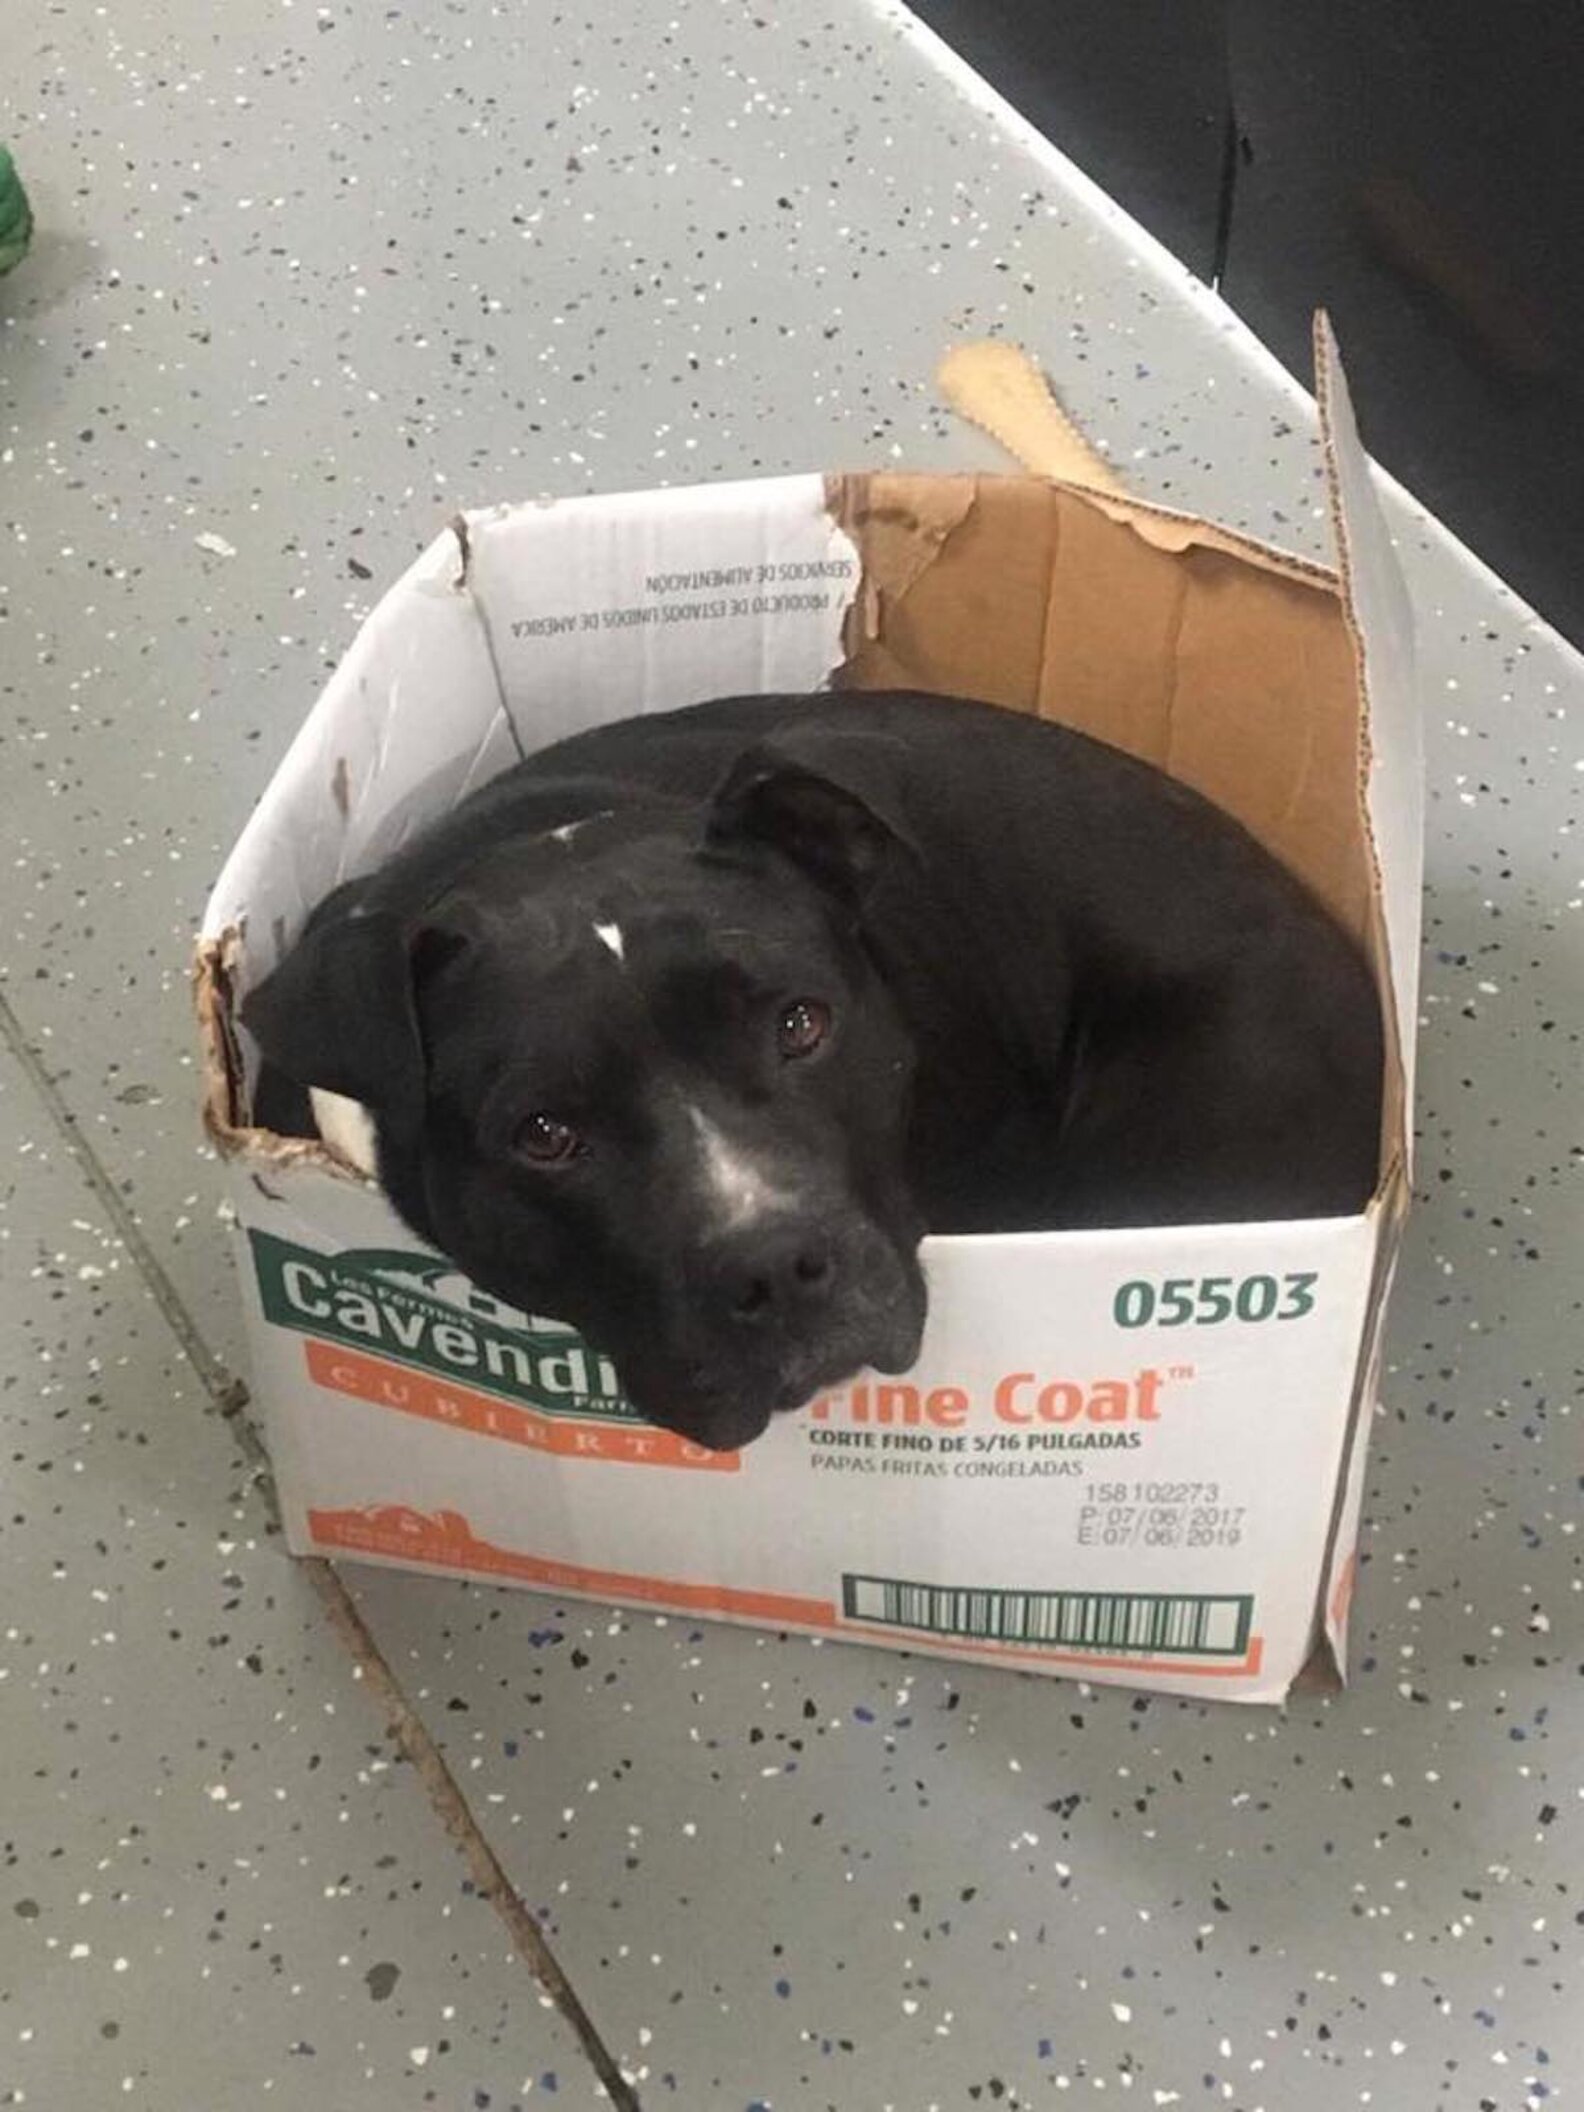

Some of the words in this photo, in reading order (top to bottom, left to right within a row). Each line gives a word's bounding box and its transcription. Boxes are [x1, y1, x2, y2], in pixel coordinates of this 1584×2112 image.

[646, 567, 753, 593] ALIMENTACIÓN
[756, 565, 776, 583] DE
[779, 560, 852, 581] SERVICIOS
[662, 601, 727, 622] ESTADOS
[730, 598, 749, 618] DE
[751, 594, 829, 615] PRODUCTO
[579, 612, 599, 630] DE
[603, 606, 659, 628] UNIDOS
[1113, 1272, 1319, 1329] 05503
[331, 1365, 714, 1461] CUBIERTO
[809, 1429, 876, 1448] CORTE
[882, 1433, 933, 1451] FINO
[940, 1436, 967, 1453] DE
[972, 1433, 1021, 1454] 5/16
[1027, 1431, 1142, 1450] PULGADAS
[811, 1454, 876, 1473] PAPAS
[882, 1459, 947, 1476] FRITAS
[954, 1459, 1084, 1478] CONGELADAS
